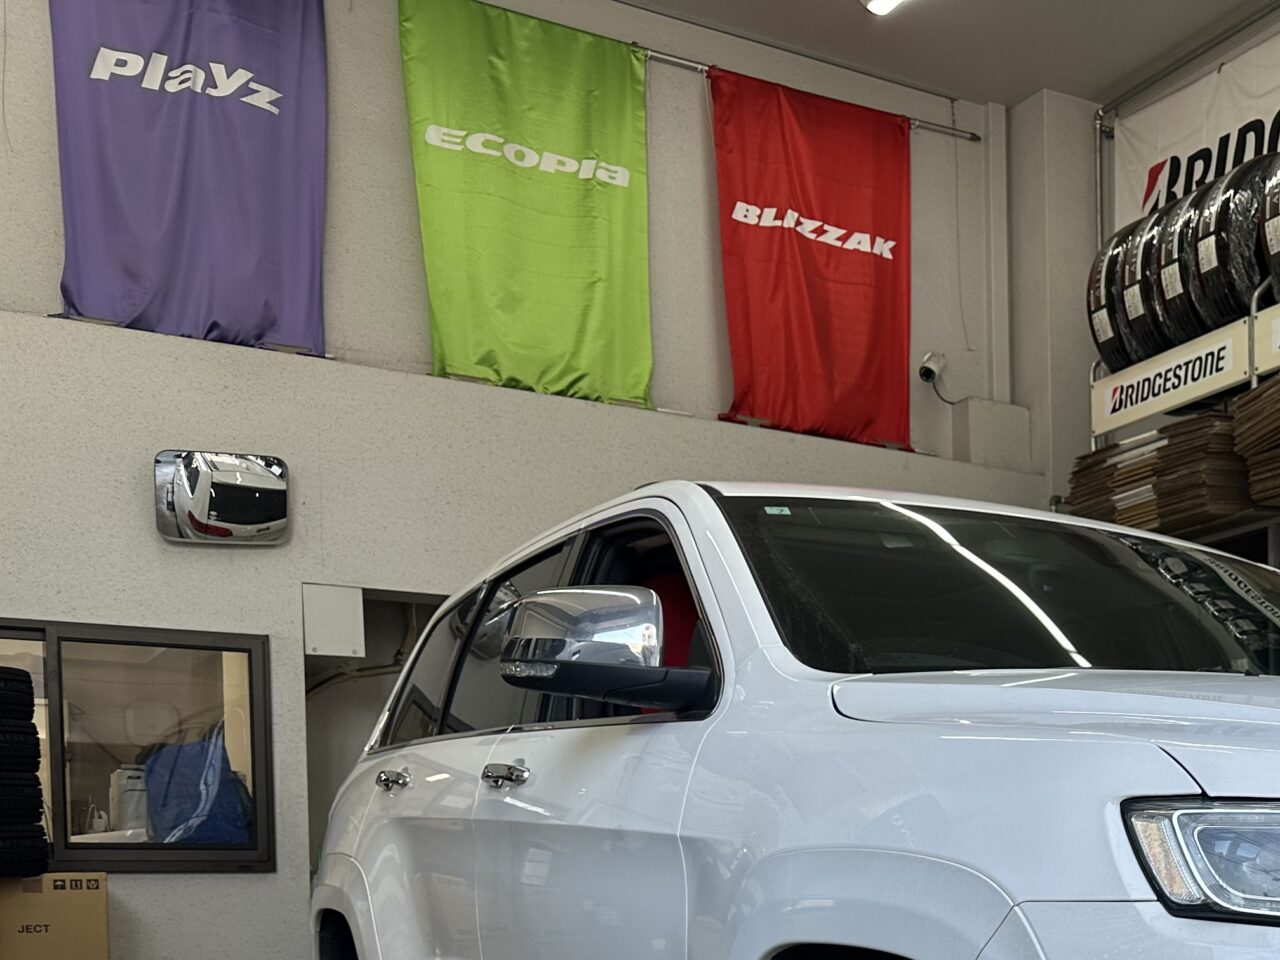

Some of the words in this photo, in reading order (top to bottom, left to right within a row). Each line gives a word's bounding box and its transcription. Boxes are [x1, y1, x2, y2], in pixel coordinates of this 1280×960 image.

[731, 201, 899, 261] BLIZZAK
[1110, 345, 1228, 416] BRIDGESTONE
[17, 924, 51, 934] JECT
